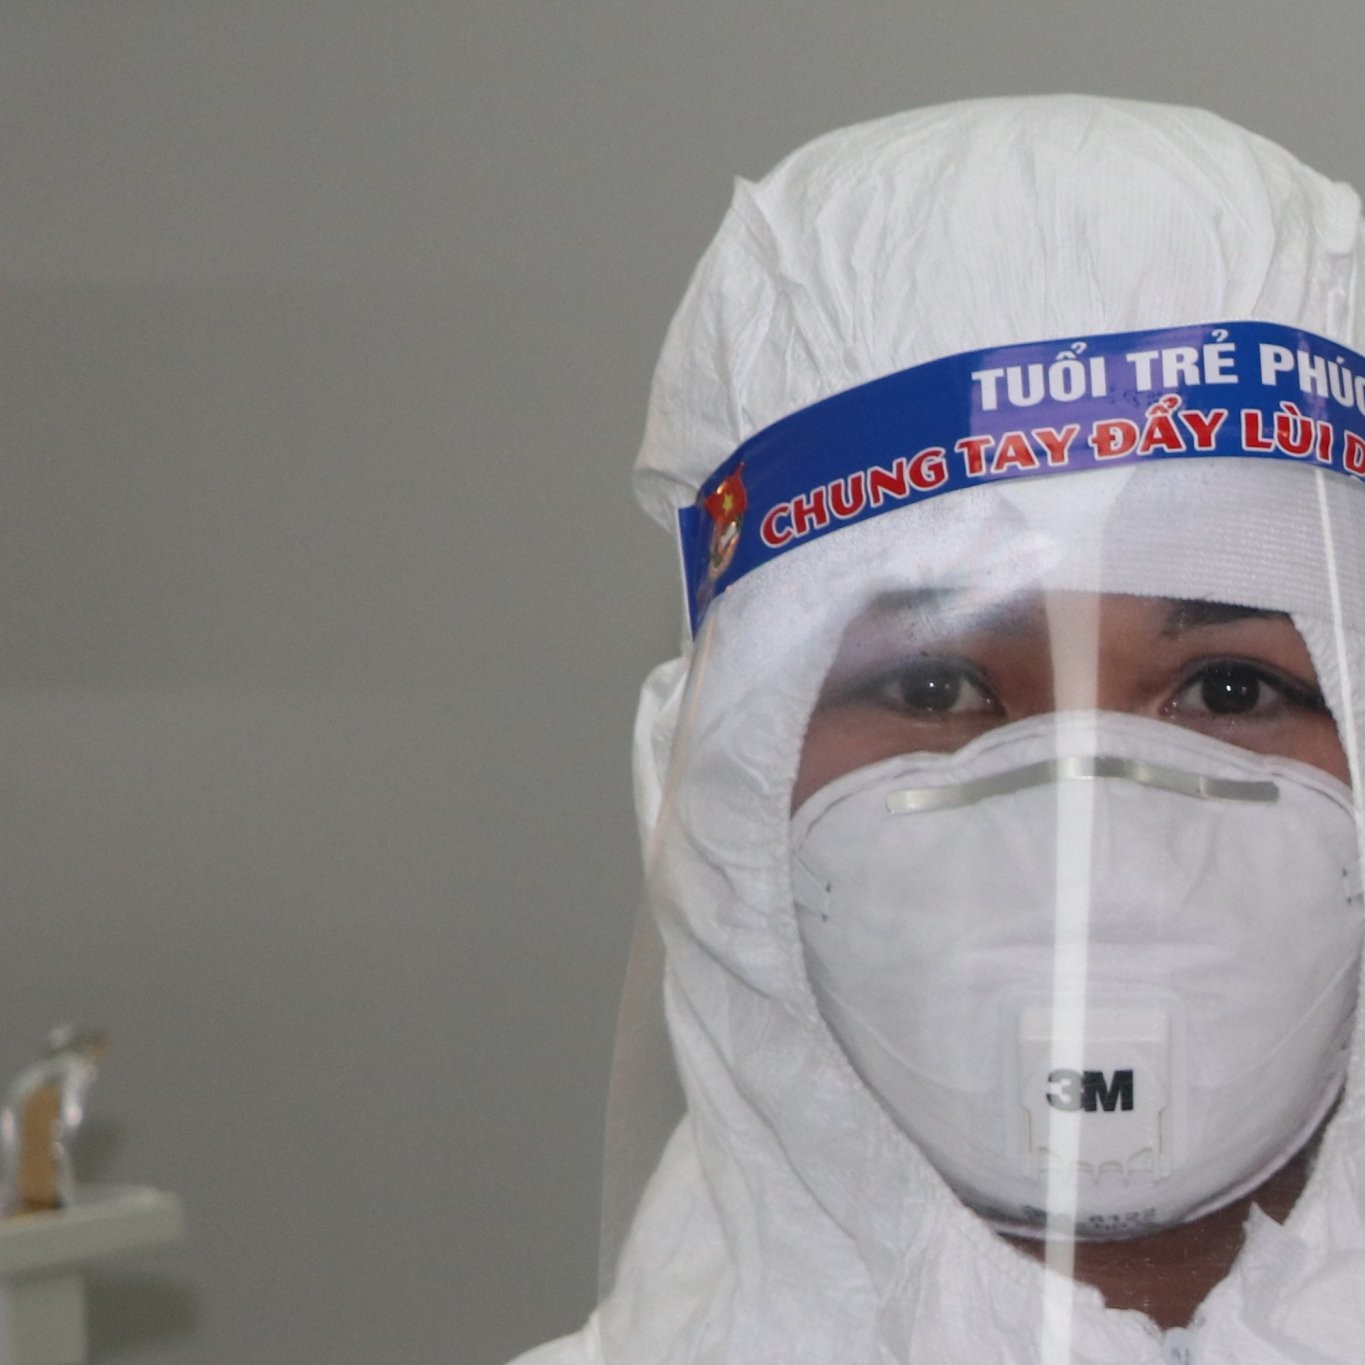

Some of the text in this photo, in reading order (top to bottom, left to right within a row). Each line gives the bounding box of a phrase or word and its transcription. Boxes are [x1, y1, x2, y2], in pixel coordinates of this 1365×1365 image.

[972, 342, 1107, 411] TUỔI
[1126, 328, 1239, 391] TRẺ
[760, 447, 949, 548] CHUNG
[955, 424, 1080, 478] TAY
[1088, 394, 1228, 460] ĐẨY
[1241, 401, 1333, 465] LÙI
[1046, 1068, 1134, 1112] 3M
